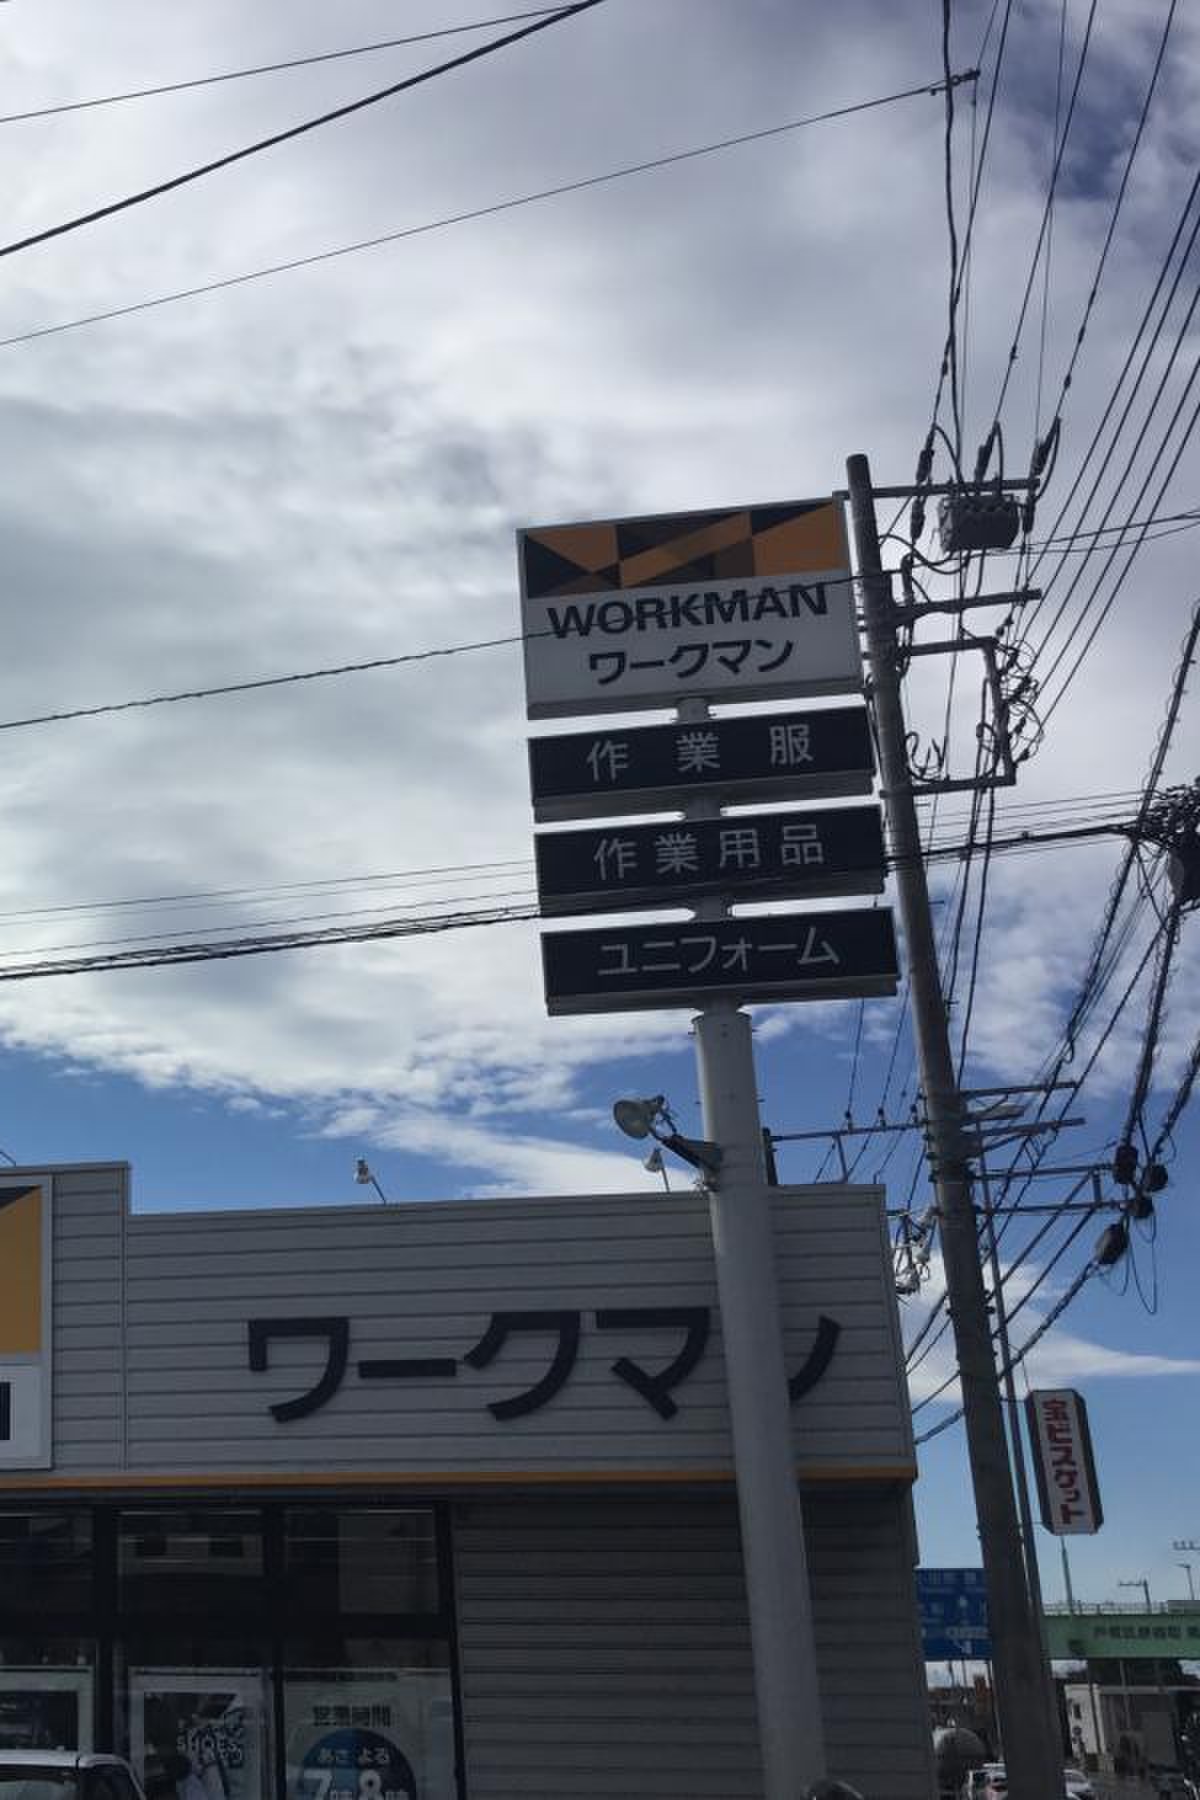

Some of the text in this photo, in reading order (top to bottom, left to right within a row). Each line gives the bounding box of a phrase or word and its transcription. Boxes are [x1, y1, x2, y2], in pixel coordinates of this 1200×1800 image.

[546, 582, 828, 639] WORKMAN
[589, 638, 794, 685] ワークマン
[586, 723, 814, 783] 作業服
[594, 823, 825, 880] 作業用品
[597, 926, 840, 976] ユニフォーム
